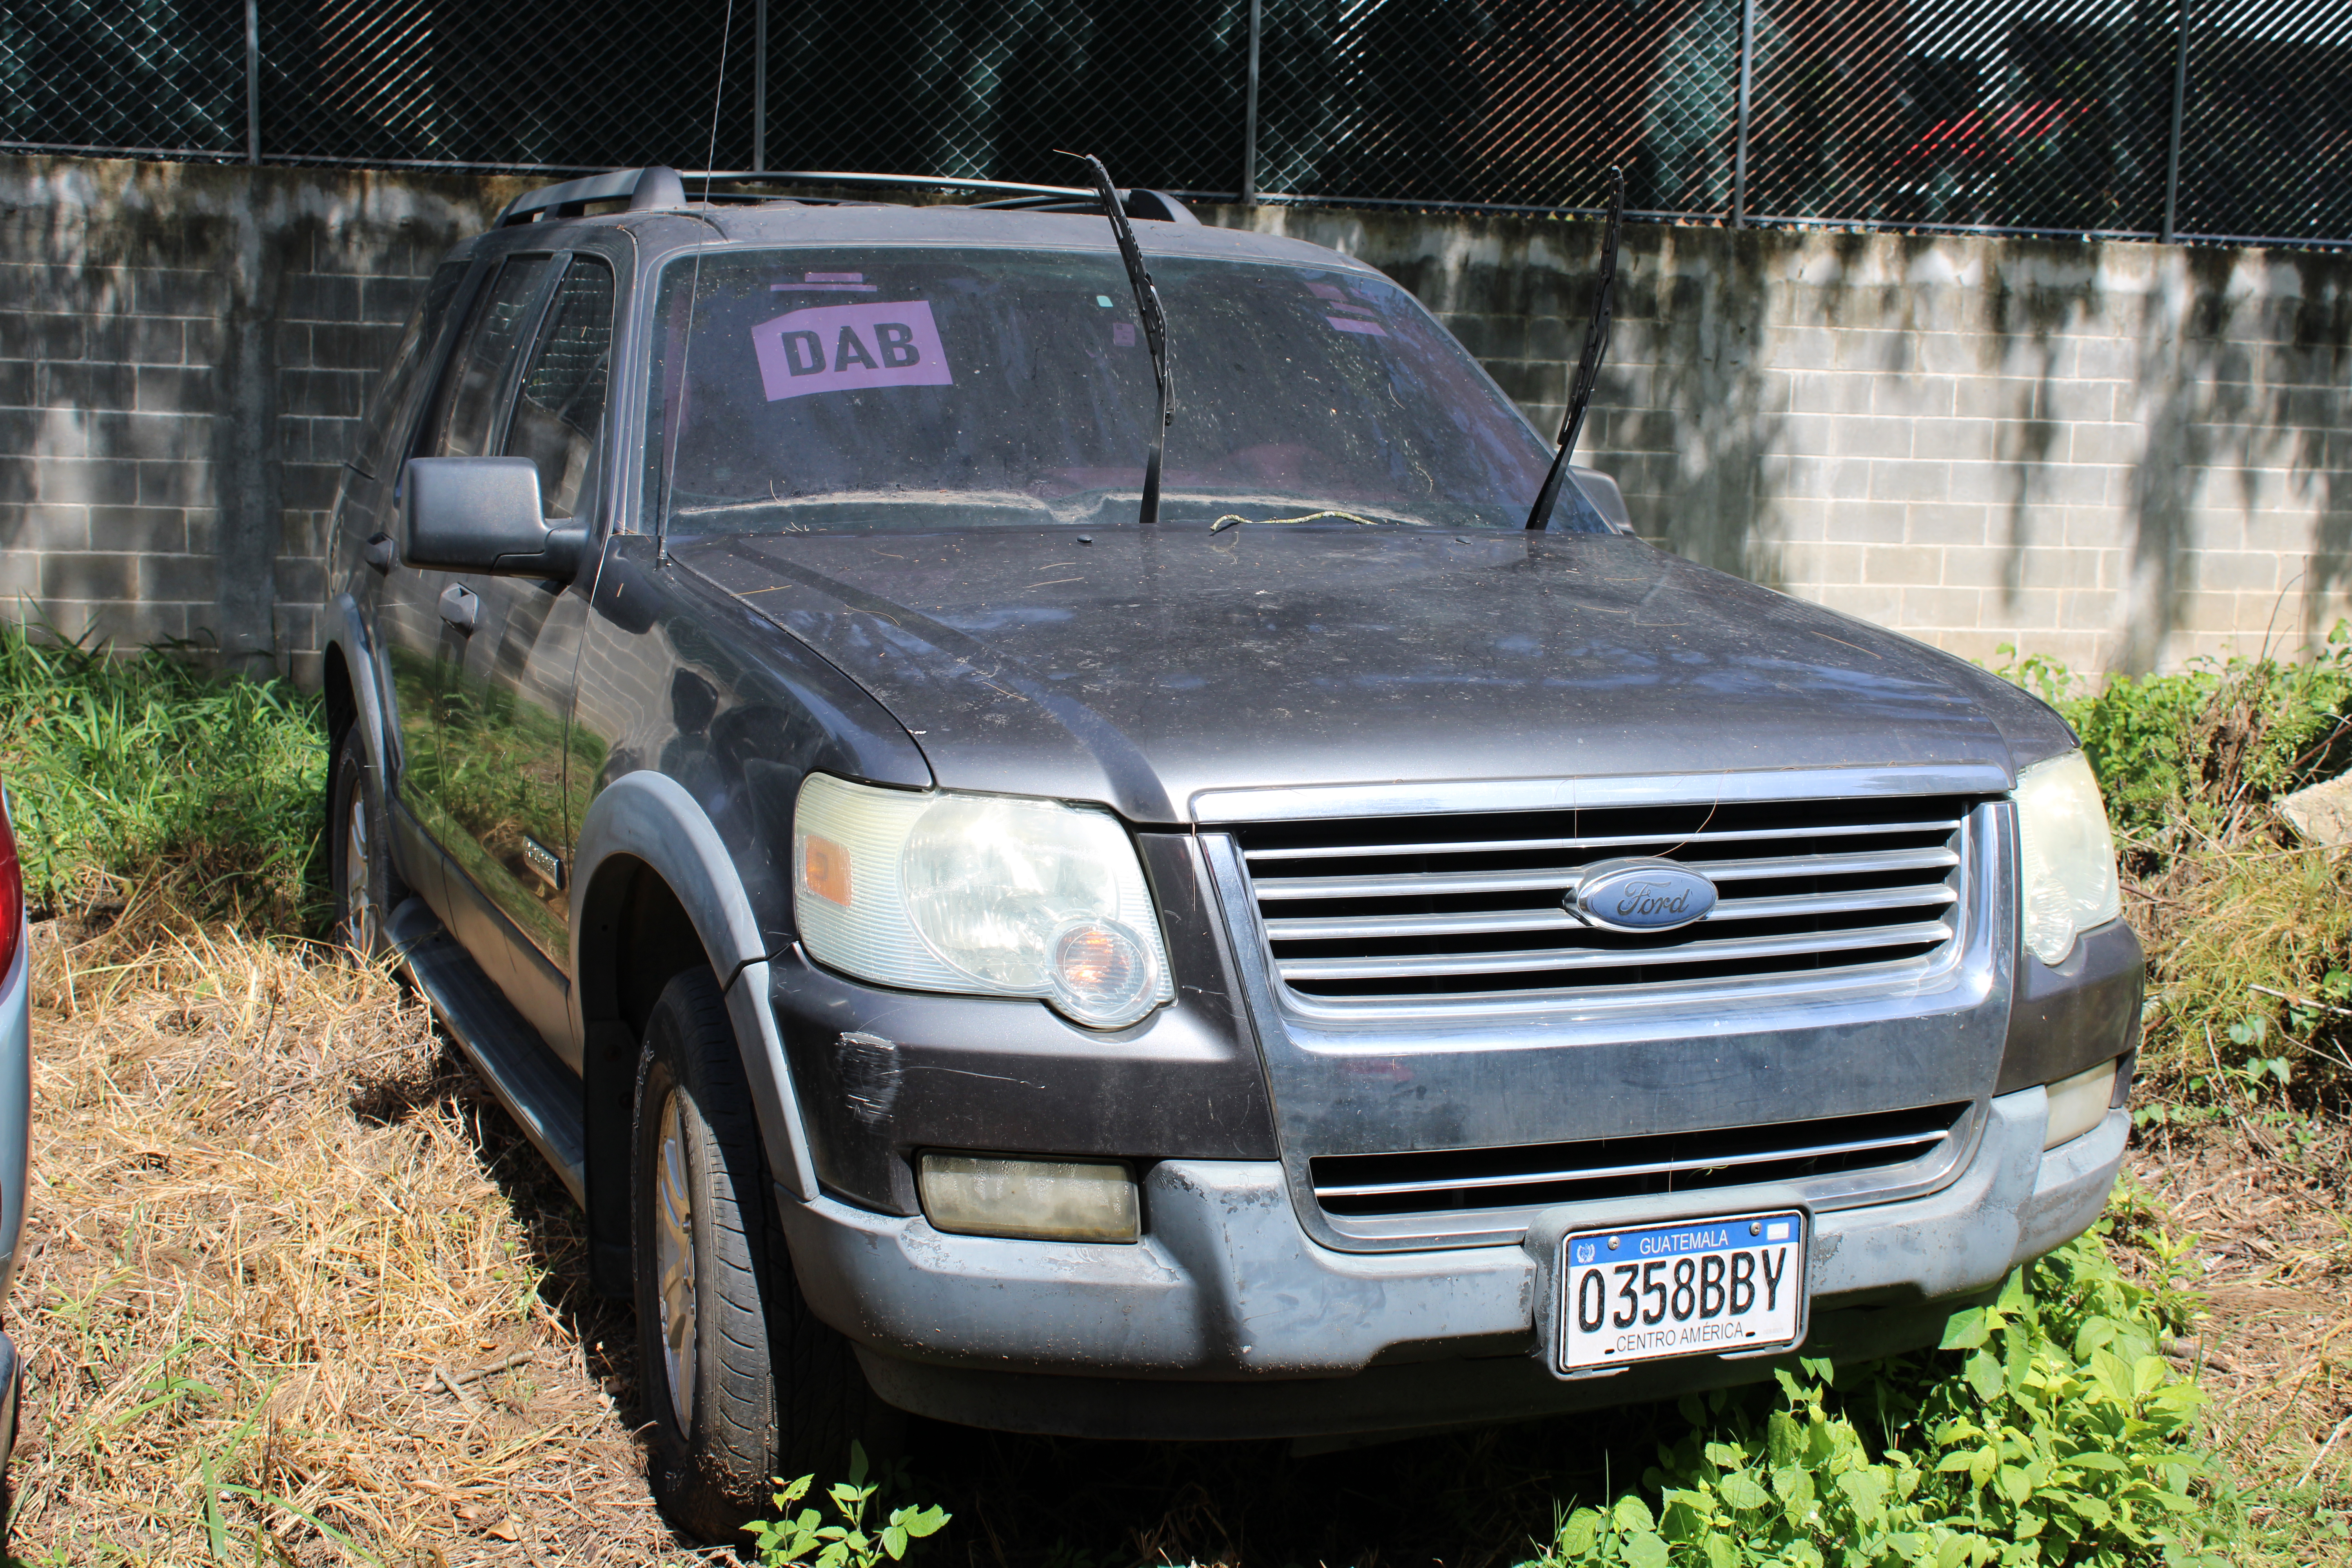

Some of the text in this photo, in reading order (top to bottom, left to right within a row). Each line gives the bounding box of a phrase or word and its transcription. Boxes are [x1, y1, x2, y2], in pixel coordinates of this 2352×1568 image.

[781, 323, 920, 377] DAB
[1617, 881, 1691, 916] Ford
[631, 1041, 654, 1281] CONTINENTAL
[1639, 1229, 1728, 1255] GUATEMALA
[1578, 1247, 1786, 1333] 0358BBY
[1617, 1321, 1743, 1352] CENTRO AMÉRICA
